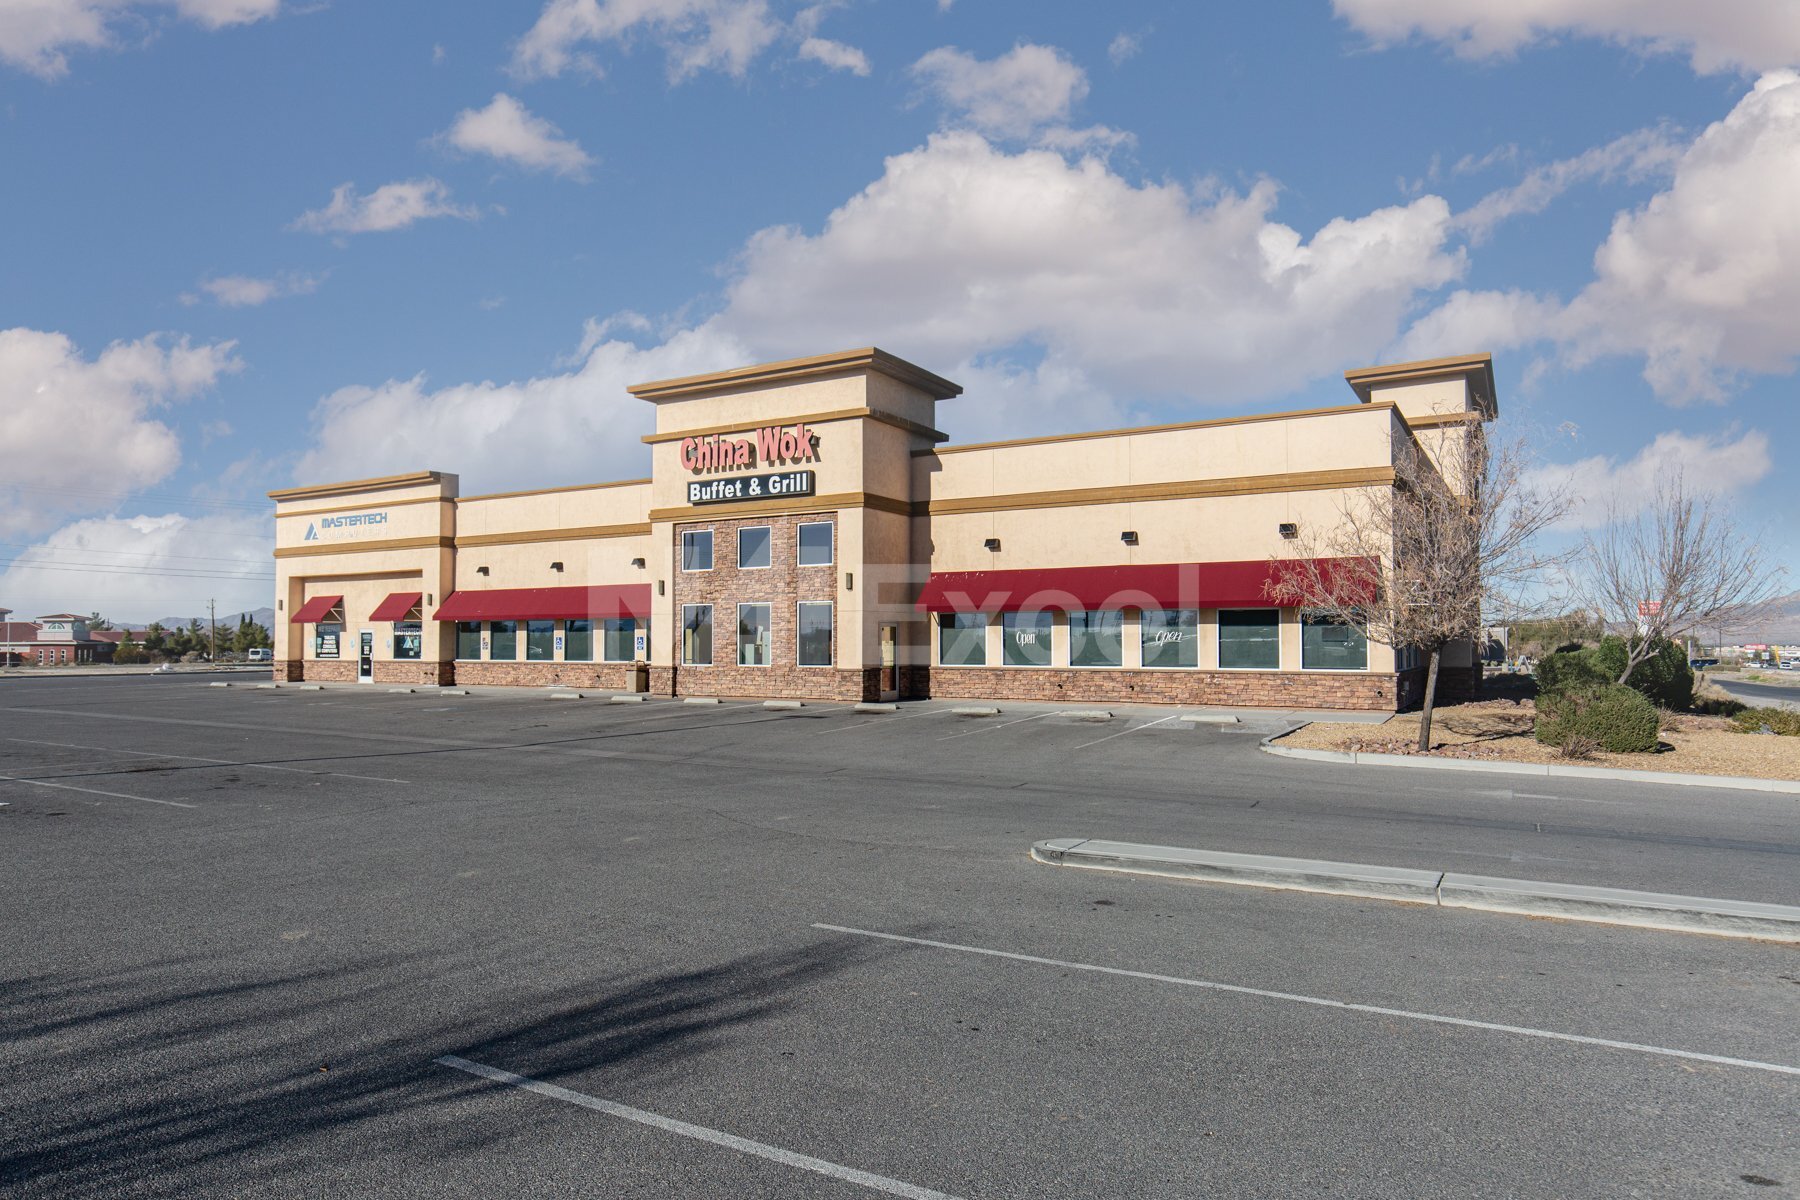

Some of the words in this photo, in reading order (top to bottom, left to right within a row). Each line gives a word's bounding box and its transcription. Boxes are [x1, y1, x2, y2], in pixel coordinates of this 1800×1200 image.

[680, 433, 750, 470] China
[756, 423, 814, 462] Wok
[690, 480, 742, 502] Buffet
[748, 477, 762, 496] &
[768, 472, 808, 494] Grill
[322, 512, 388, 529] MASTERTECH
[1016, 631, 1036, 648] Open
[1155, 630, 1184, 647] Open
